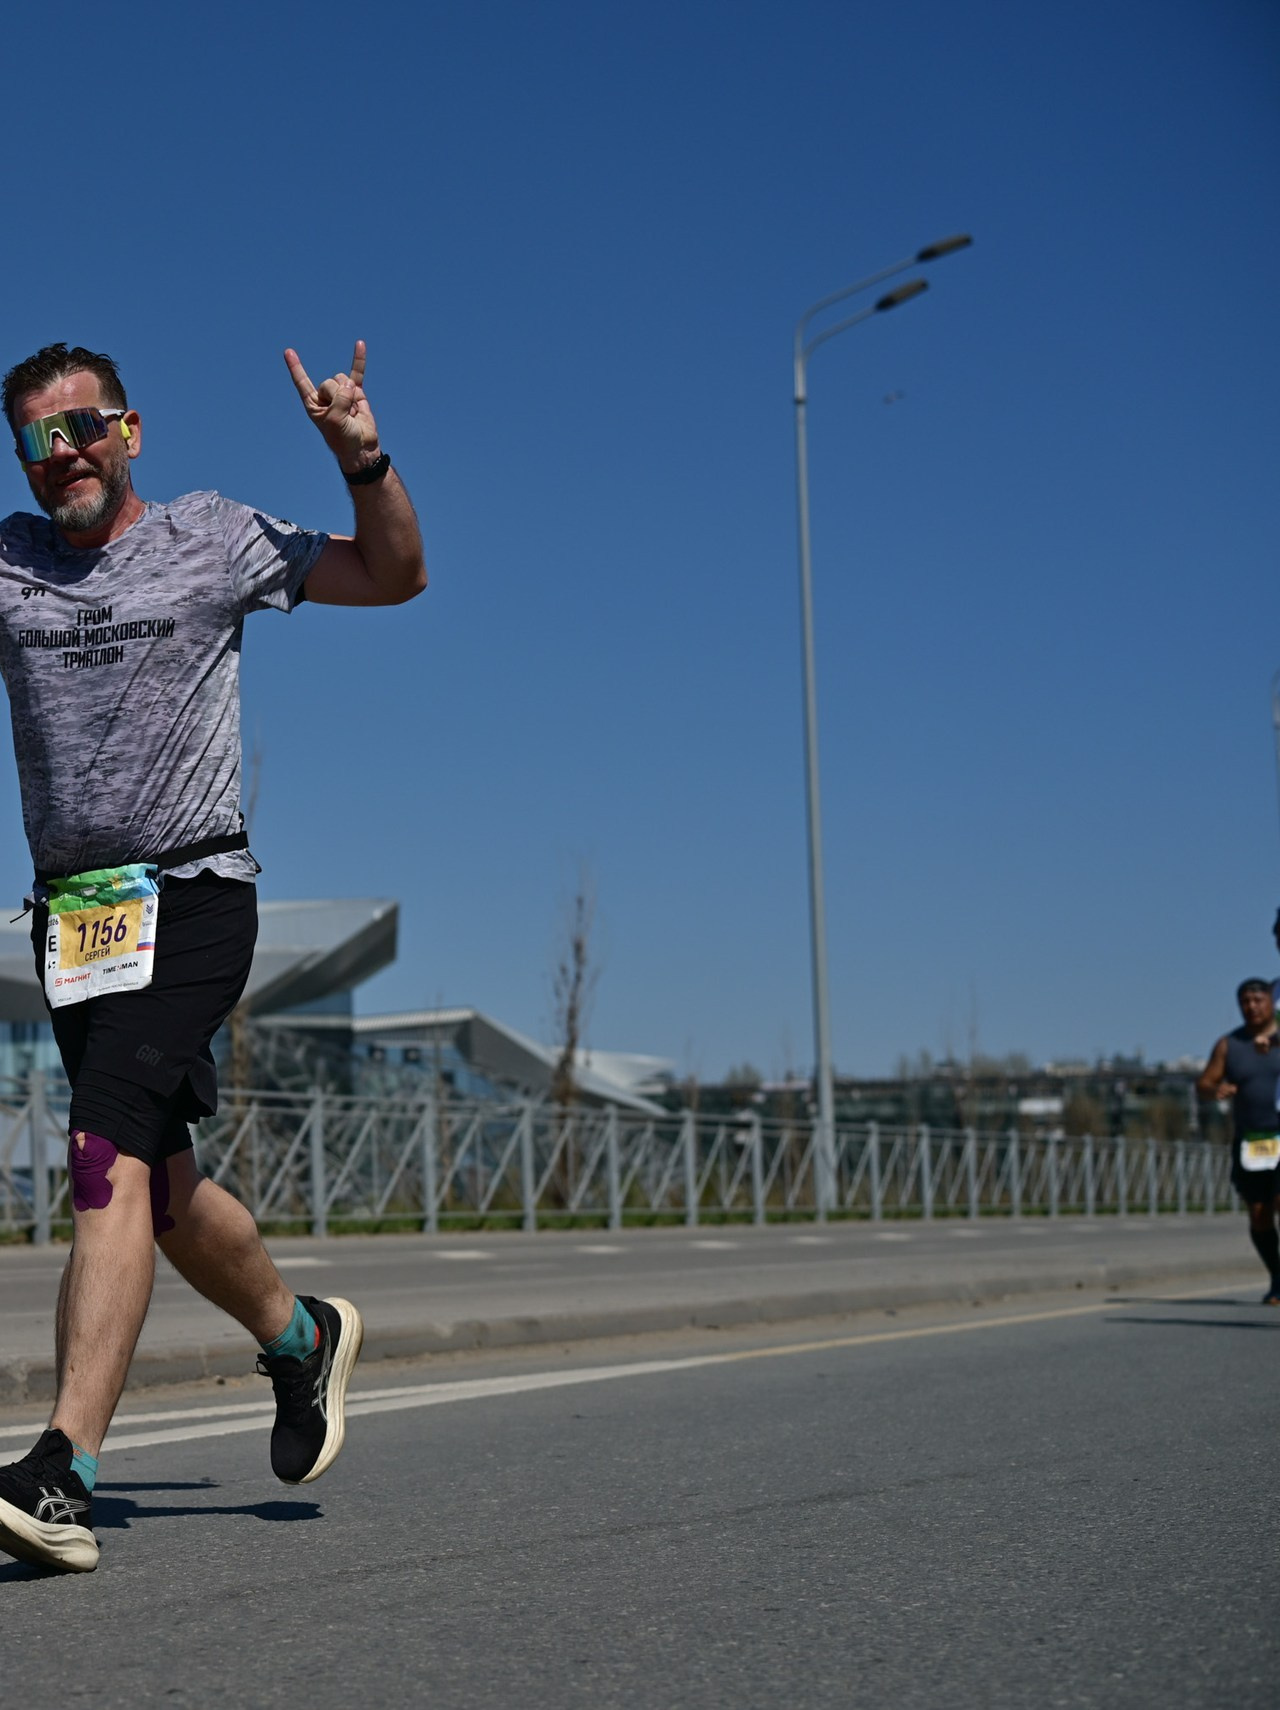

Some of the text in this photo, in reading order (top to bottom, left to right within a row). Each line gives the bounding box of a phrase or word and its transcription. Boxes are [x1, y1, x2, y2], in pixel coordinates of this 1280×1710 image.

[77, 606, 113, 626] ГРОМ
[19, 617, 175, 648] БОЛЬШОЙ МОСКОВСКИЙ
[63, 645, 124, 668] ТРИАТЛОН
[77, 914, 127, 952] 1156
[48, 935, 57, 952] E
[85, 946, 111, 961] СЕРГЕЙ
[64, 973, 91, 984] МАГНИТ
